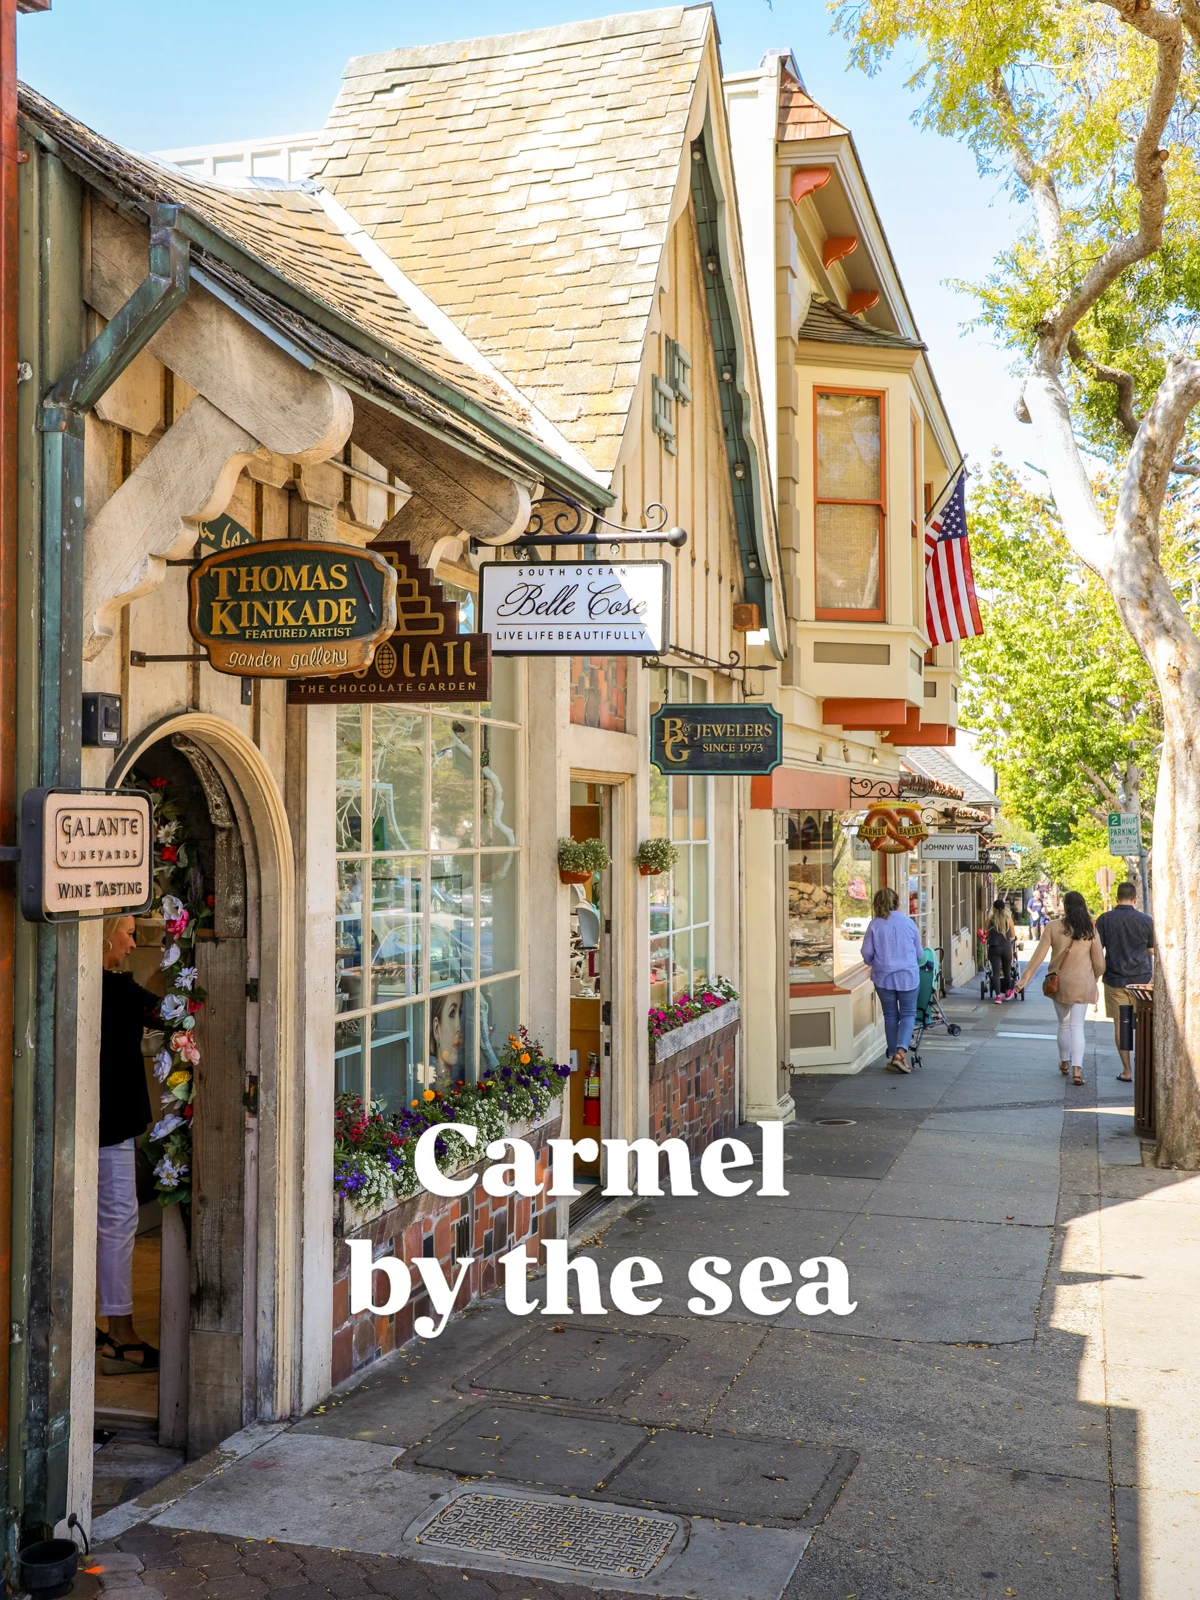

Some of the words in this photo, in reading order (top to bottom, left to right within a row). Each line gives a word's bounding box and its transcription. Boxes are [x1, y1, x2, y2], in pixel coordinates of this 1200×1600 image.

[518, 568, 565, 576] SOUTH
[576, 568, 627, 577] OCEAN
[210, 563, 348, 600] THOMAS
[496, 582, 579, 617] Belle
[587, 581, 648, 620] Cose
[210, 598, 357, 635] KINKADE
[245, 628, 307, 640] FEATURED
[309, 627, 352, 638] ARTIST
[496, 631, 523, 640] LIVE
[527, 631, 553, 640] LIFE
[558, 630, 646, 640] BEAUTIFULLY
[225, 648, 282, 668] garden
[288, 646, 349, 671] gallery
[300, 684, 325, 694] THE
[330, 683, 413, 693] CHOCOLATE
[418, 682, 476, 692] GARDEN
[694, 723, 772, 741] JEWELERS
[702, 743, 736, 753] SINCE
[739, 743, 763, 754] 1973
[1111, 815, 1119, 825] 2
[1122, 817, 1137, 825] HOUR
[61, 815, 139, 844] GALANTE
[860, 826, 886, 836] CARMEL
[899, 825, 923, 836] BAKERY
[1111, 828, 1137, 837] PARKING
[61, 850, 138, 862] VINEYARDS
[57, 883, 92, 899] WINE
[95, 881, 143, 897] TASTING
